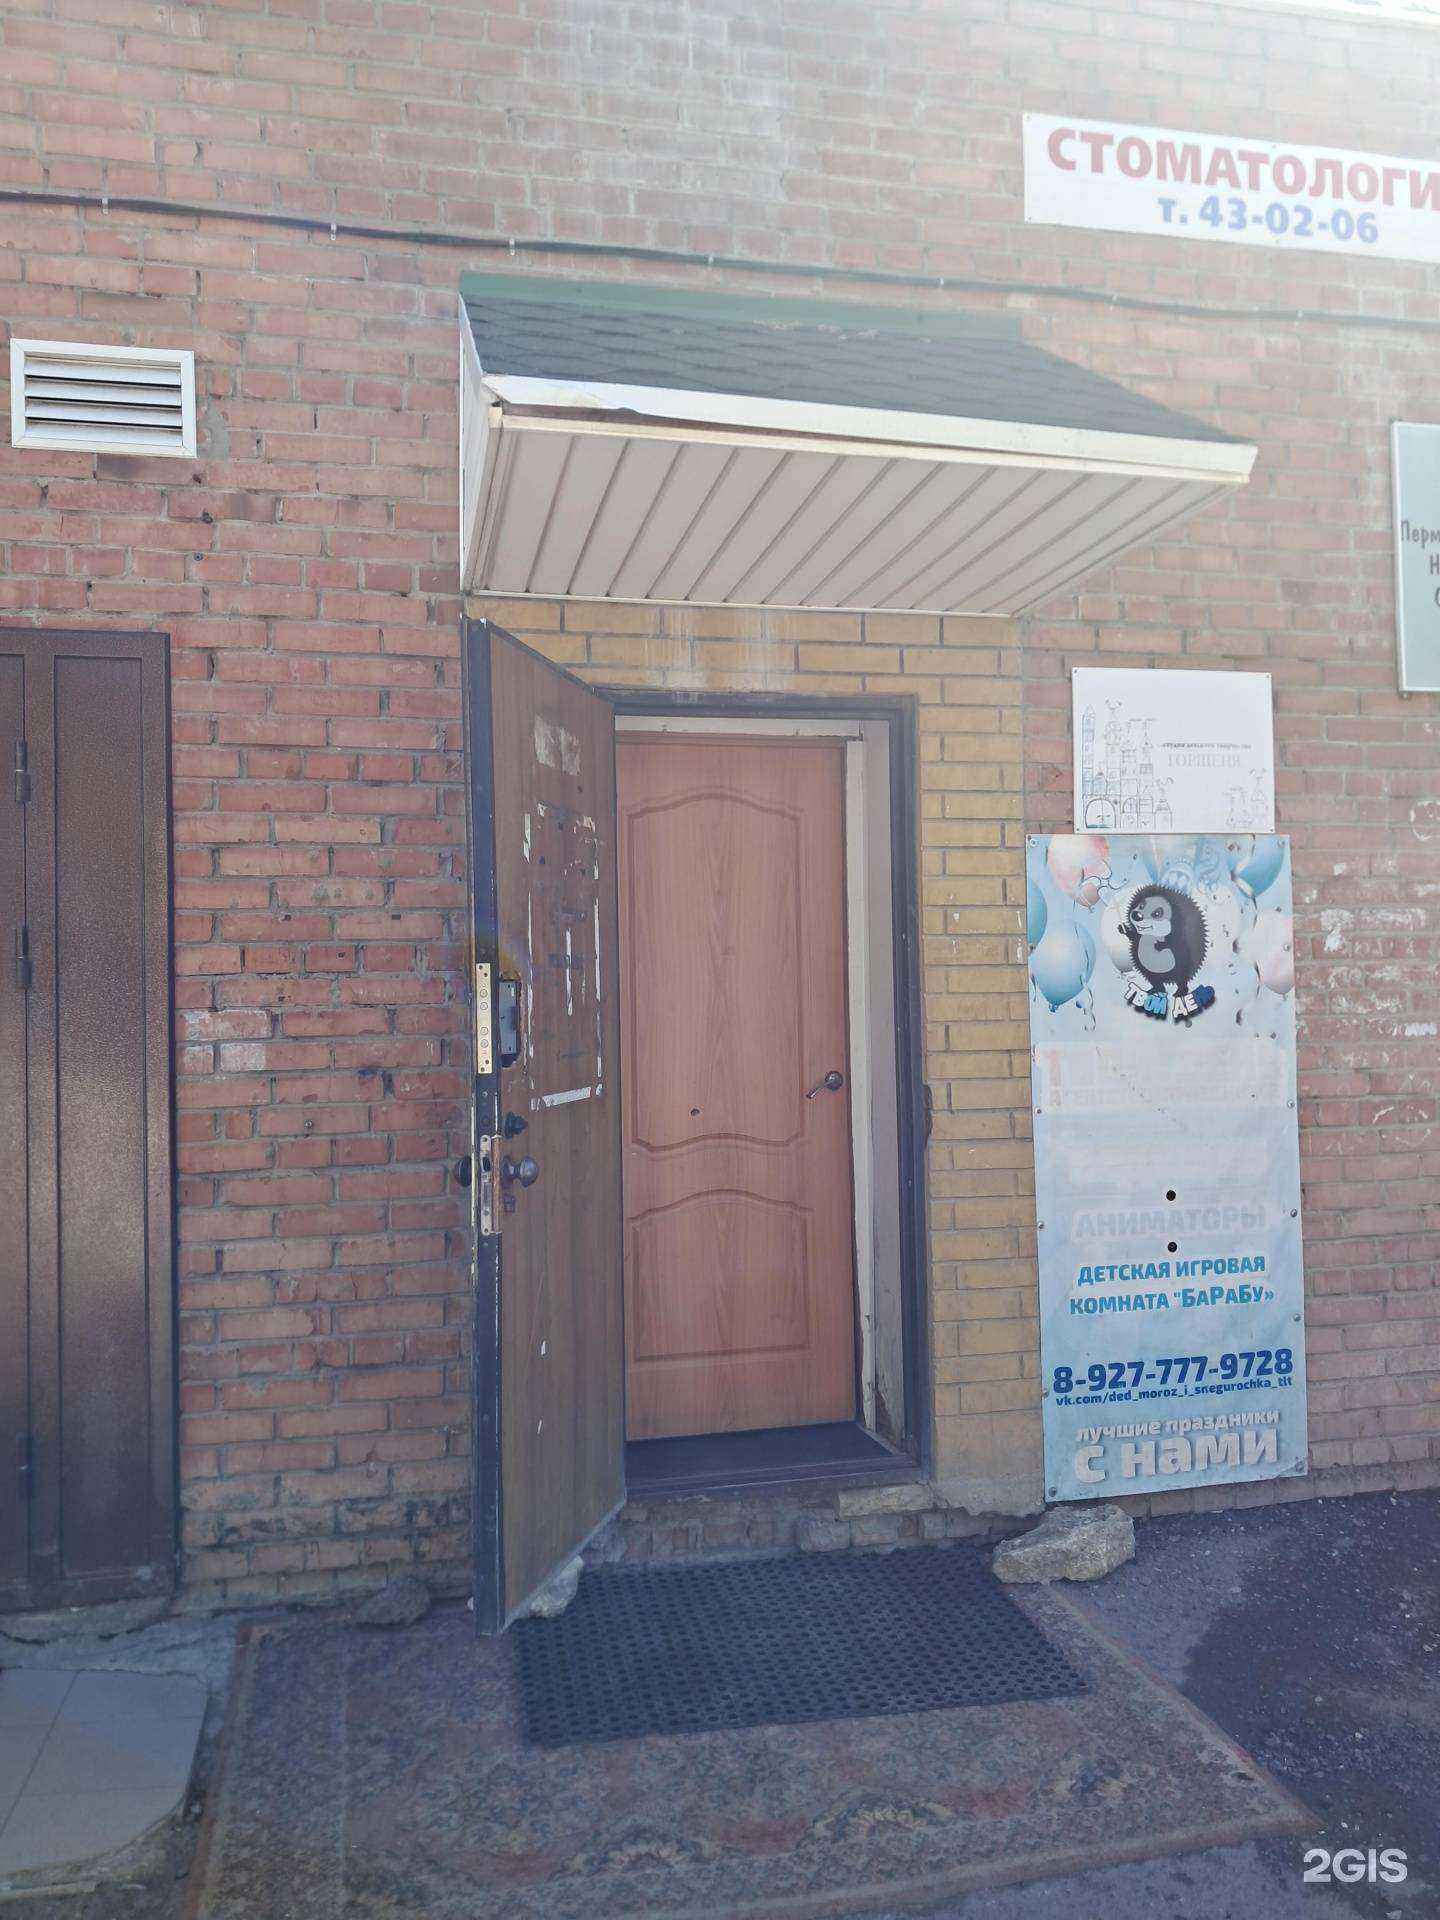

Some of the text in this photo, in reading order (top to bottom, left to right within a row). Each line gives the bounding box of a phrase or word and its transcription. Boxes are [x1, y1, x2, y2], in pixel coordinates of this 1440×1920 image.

[1199, 195, 1379, 244] 43-02-06
[1076, 1206, 1266, 1237] АНИМАТОРЫ
[1077, 1255, 1266, 1286] ДЕТСКАЯ ИГРОВАЯ
[1070, 1292, 1170, 1315] КОМНАТА
[1053, 1348, 1293, 1393] 8-927-777-9728
[1055, 1376, 1293, 1406] vk.com/ded_moroz_i_snegurochka_tlt
[1076, 1409, 1280, 1443] лучшие праздники
[1121, 1428, 1279, 1479] нами
